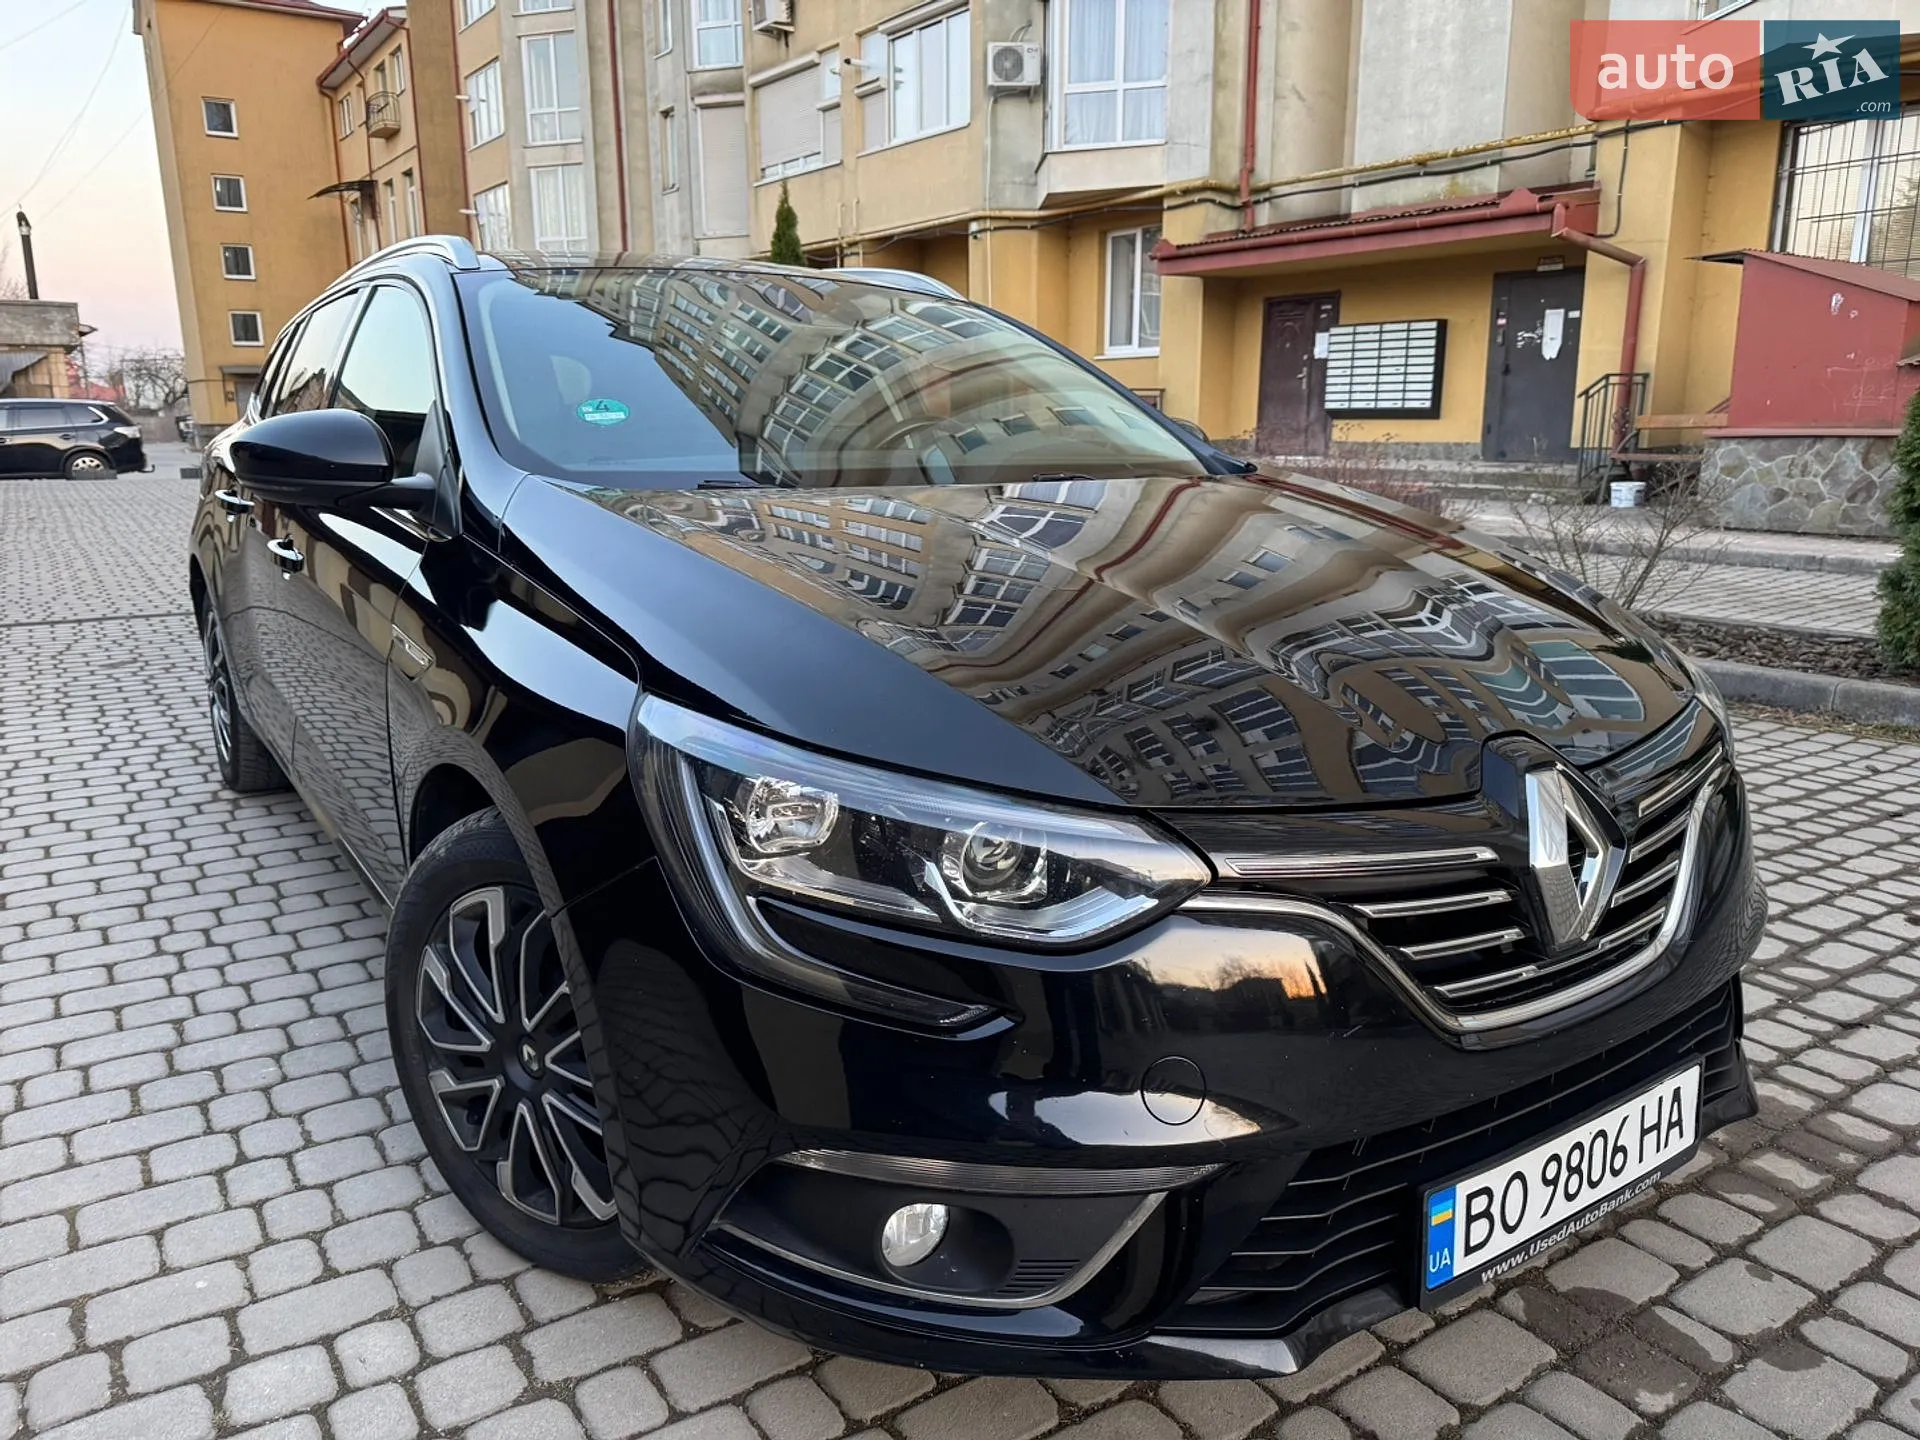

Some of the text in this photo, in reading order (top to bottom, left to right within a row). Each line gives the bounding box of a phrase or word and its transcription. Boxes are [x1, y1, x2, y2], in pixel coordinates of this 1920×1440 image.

[1464, 1085, 1684, 1257] BO 9806 HA
[1481, 1171, 1662, 1284] www.UsedAutoBank.com
[1429, 1247, 1451, 1272] UA
